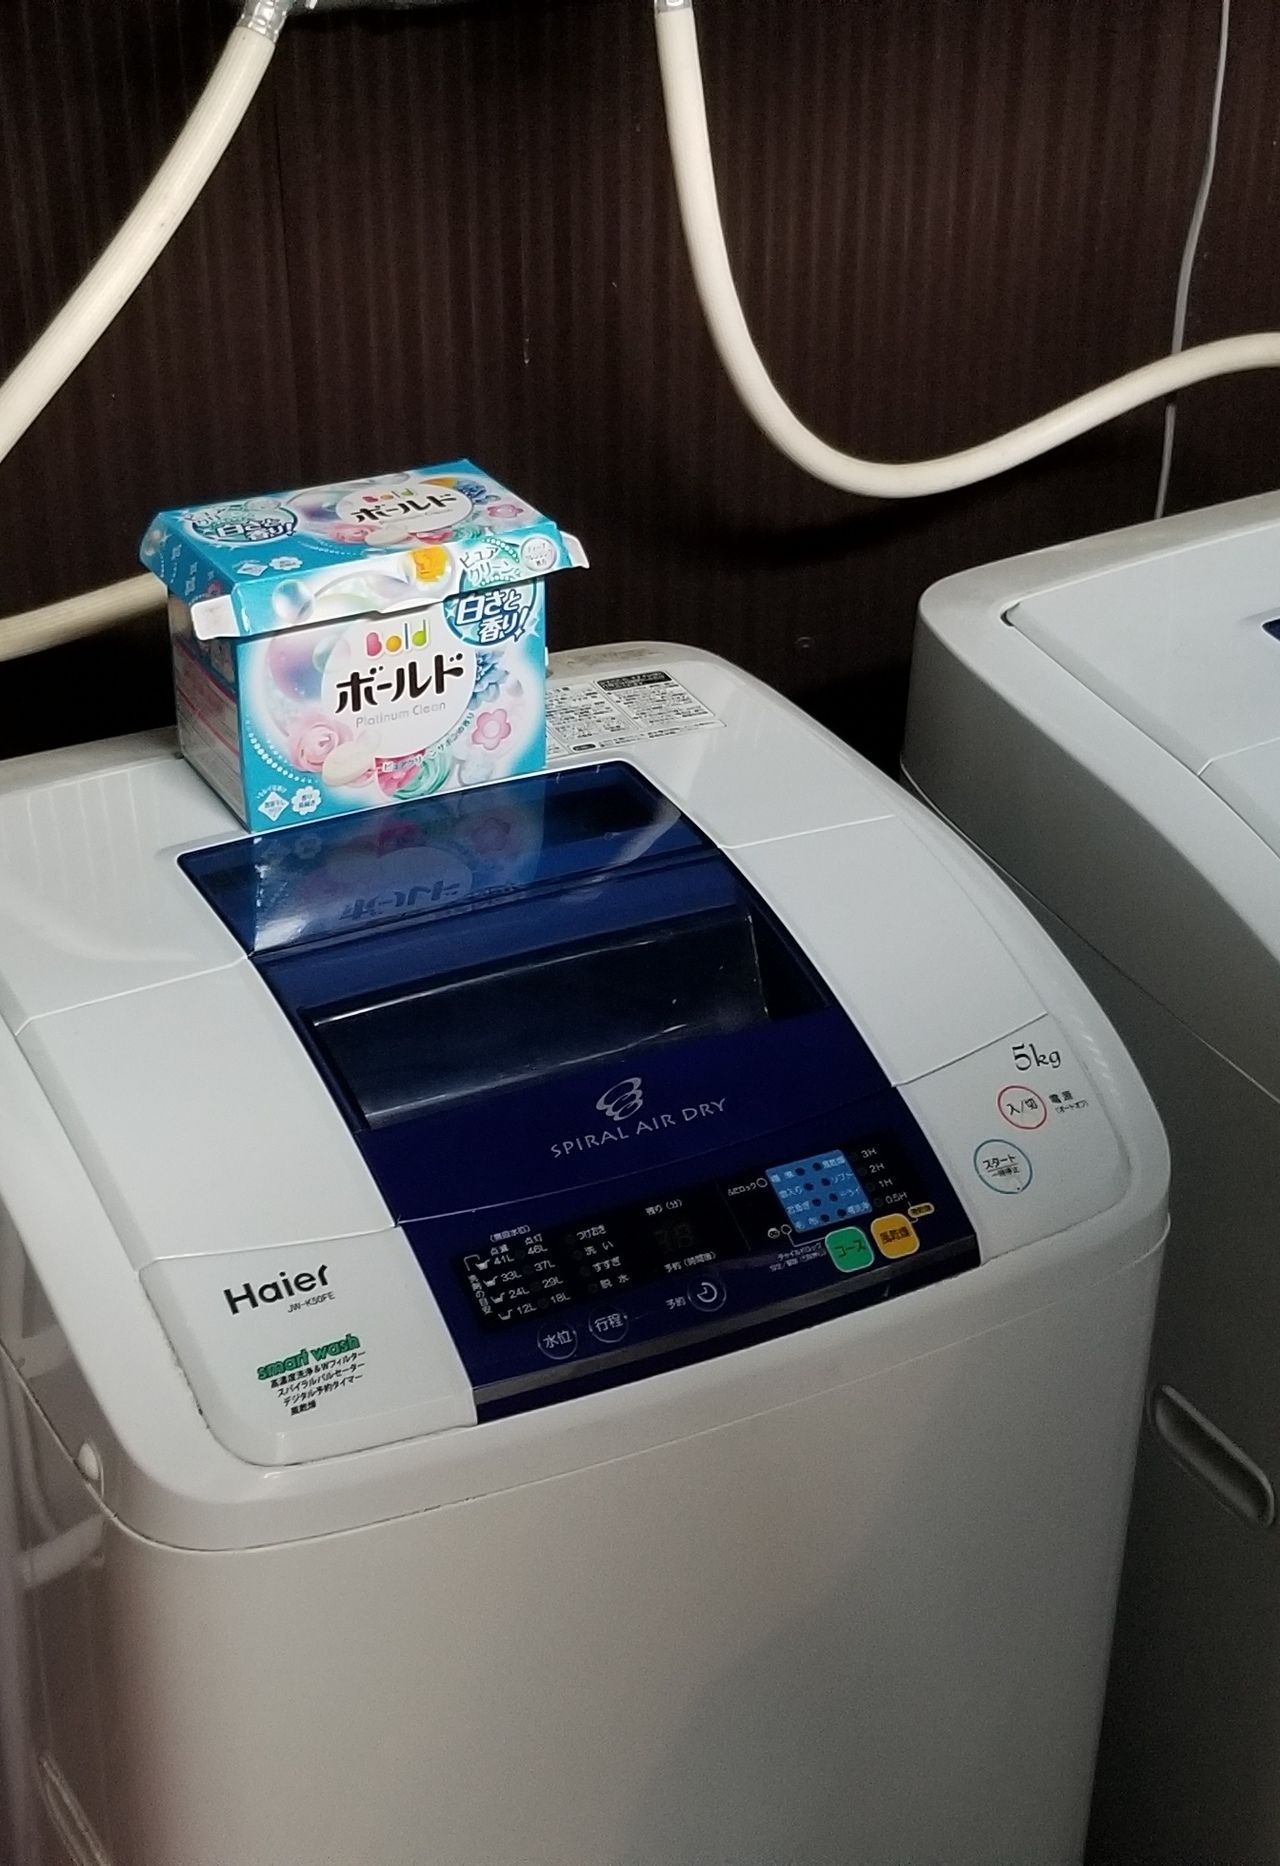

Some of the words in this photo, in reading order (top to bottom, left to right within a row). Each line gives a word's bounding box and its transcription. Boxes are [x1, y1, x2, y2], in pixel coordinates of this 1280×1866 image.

[350, 494, 457, 523] ボールド
[460, 547, 499, 568] ピュア
[456, 589, 521, 626] 白さと
[366, 619, 427, 657] Bold
[335, 653, 464, 714] ボールド
[356, 709, 410, 728] Platinum
[412, 701, 446, 717] Clean
[1012, 1043, 1061, 1071] 5kg
[550, 1127, 630, 1158] SPIRAL
[635, 1114, 676, 1135] AIR
[681, 1098, 726, 1121] DRY
[860, 1147, 878, 1159] 3H
[983, 1154, 1017, 1170] スタート
[868, 1162, 885, 1174] 2H
[878, 1178, 893, 1188] 1H
[527, 1244, 548, 1255] 46L
[834, 1239, 867, 1258] コース
[493, 1255, 515, 1266] 41L
[533, 1260, 556, 1272] 37L
[592, 1256, 622, 1273] すすぎ
[500, 1270, 522, 1282] 33L
[223, 1264, 328, 1315] Haier
[508, 1287, 530, 1299] 24L
[550, 1292, 572, 1304] 18L
[287, 1291, 335, 1313] JW-K50FE
[516, 1303, 538, 1315] 12L
[665, 1297, 687, 1310] 予約
[594, 1313, 624, 1333] 行程
[542, 1329, 573, 1349] 水位
[257, 1349, 309, 1380] smart
[310, 1333, 360, 1361] wash
[283, 1375, 363, 1407] デジタル予約タイマー
